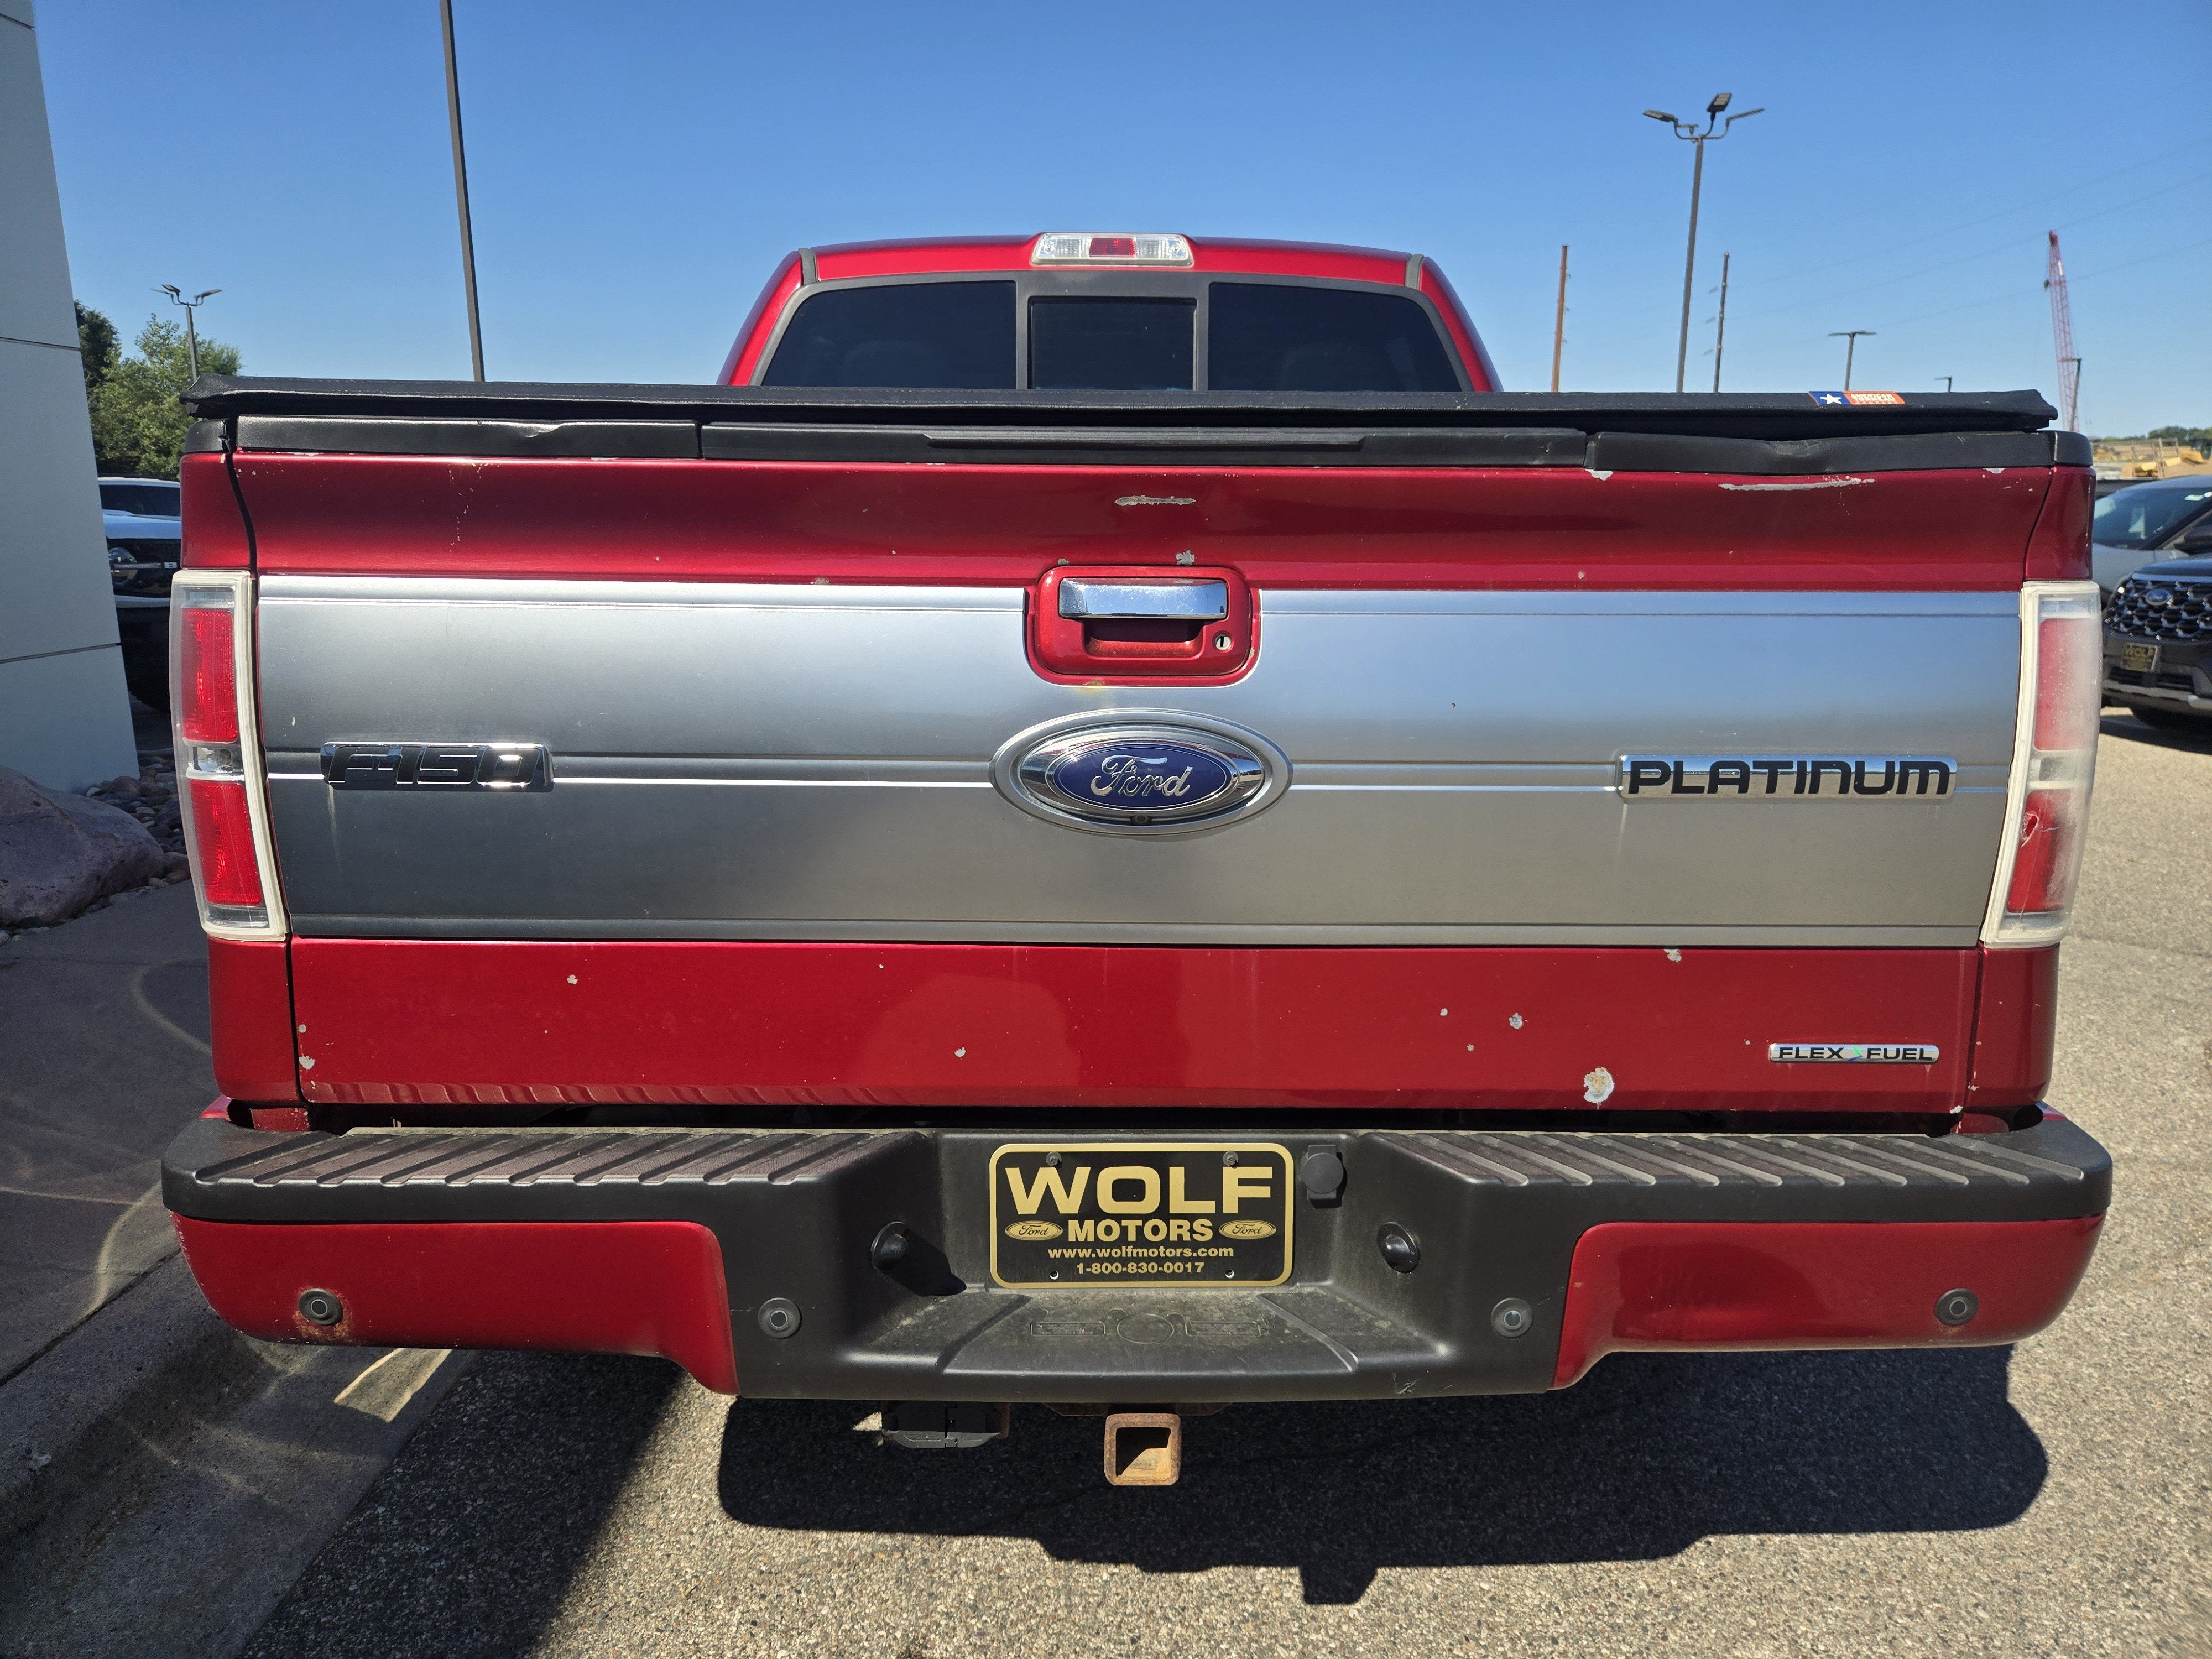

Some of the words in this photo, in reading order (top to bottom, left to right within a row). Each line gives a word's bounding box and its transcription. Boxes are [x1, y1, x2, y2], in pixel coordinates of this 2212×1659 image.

[1091, 754, 1193, 797] Ford
[1627, 760, 1950, 795] PLATINUM
[1778, 1047, 1845, 1060] FLEX
[1866, 1047, 1933, 1061] FUEL
[1005, 1166, 1273, 1214] WOLF
[1018, 1224, 1049, 1235] Ford
[1068, 1219, 1214, 1241] MOTORS
[1232, 1223, 1262, 1234] Ford
[1047, 1245, 1234, 1258] www.wolfmotors.com
[1076, 1262, 1205, 1274] 1-800-830-0017
